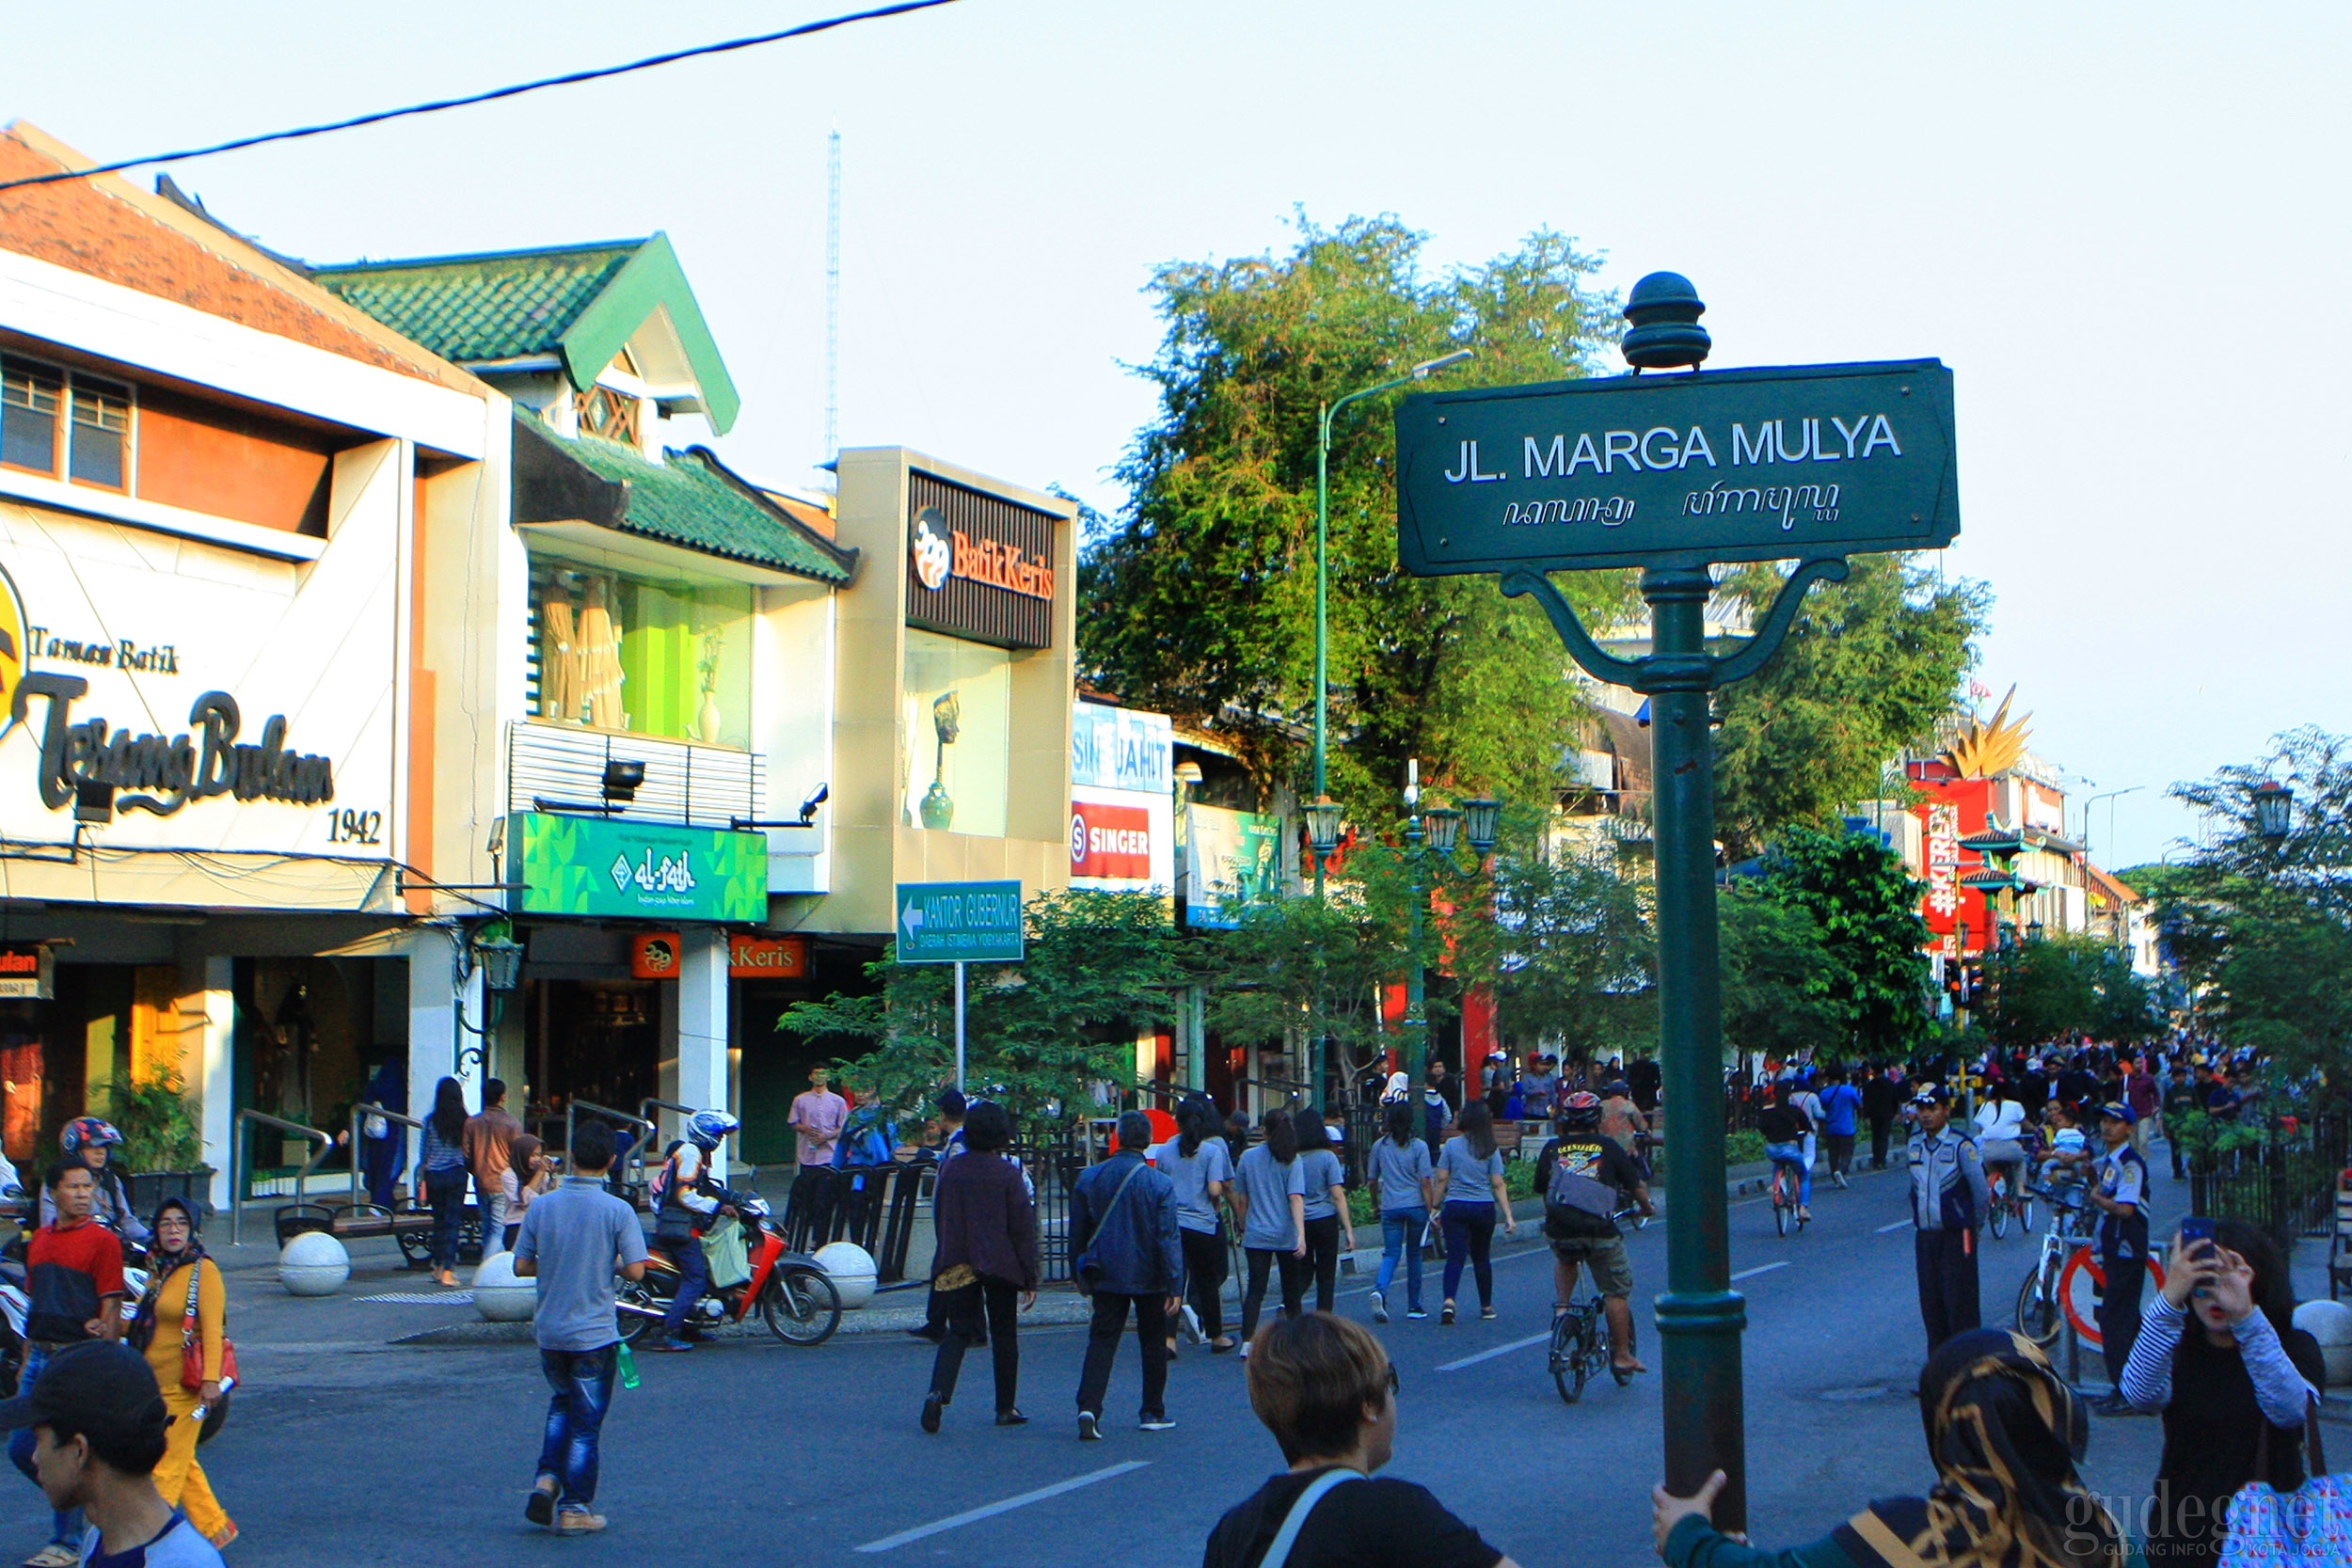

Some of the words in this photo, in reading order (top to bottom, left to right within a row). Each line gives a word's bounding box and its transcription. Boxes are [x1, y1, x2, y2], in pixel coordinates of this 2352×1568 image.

[1444, 439, 1507, 483] JL.
[1524, 425, 1718, 480] MARGA
[1732, 414, 1902, 467] MULYA
[29, 626, 112, 665] Taman
[117, 639, 179, 674] Batik
[188, 690, 334, 807] Bulan
[326, 808, 382, 845] 1942
[1089, 826, 1149, 855] SINGER
[923, 895, 962, 928] KANTOR
[965, 893, 1018, 927] GUBERNUR
